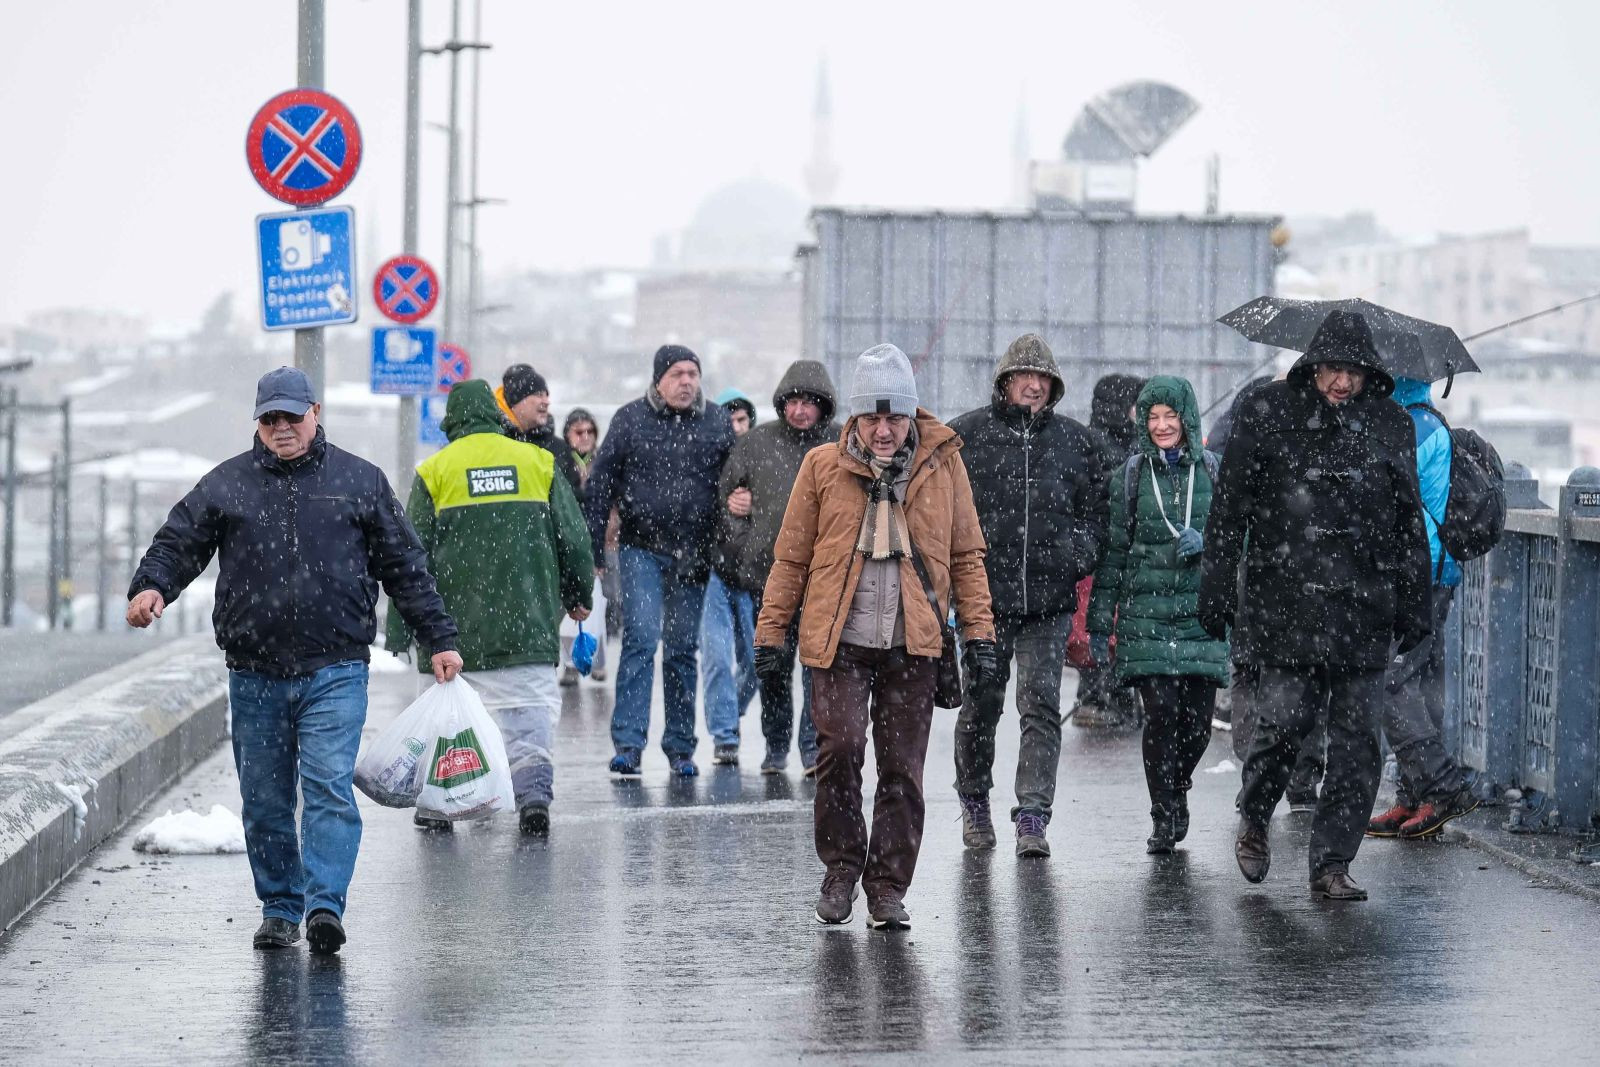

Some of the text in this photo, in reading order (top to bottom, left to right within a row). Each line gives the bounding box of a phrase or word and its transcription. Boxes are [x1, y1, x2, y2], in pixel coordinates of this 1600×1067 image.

[268, 272, 345, 290] Elektronik
[267, 289, 329, 307] Denetle
[471, 469, 513, 478] Pflanzen
[472, 477, 514, 493] Kölle
